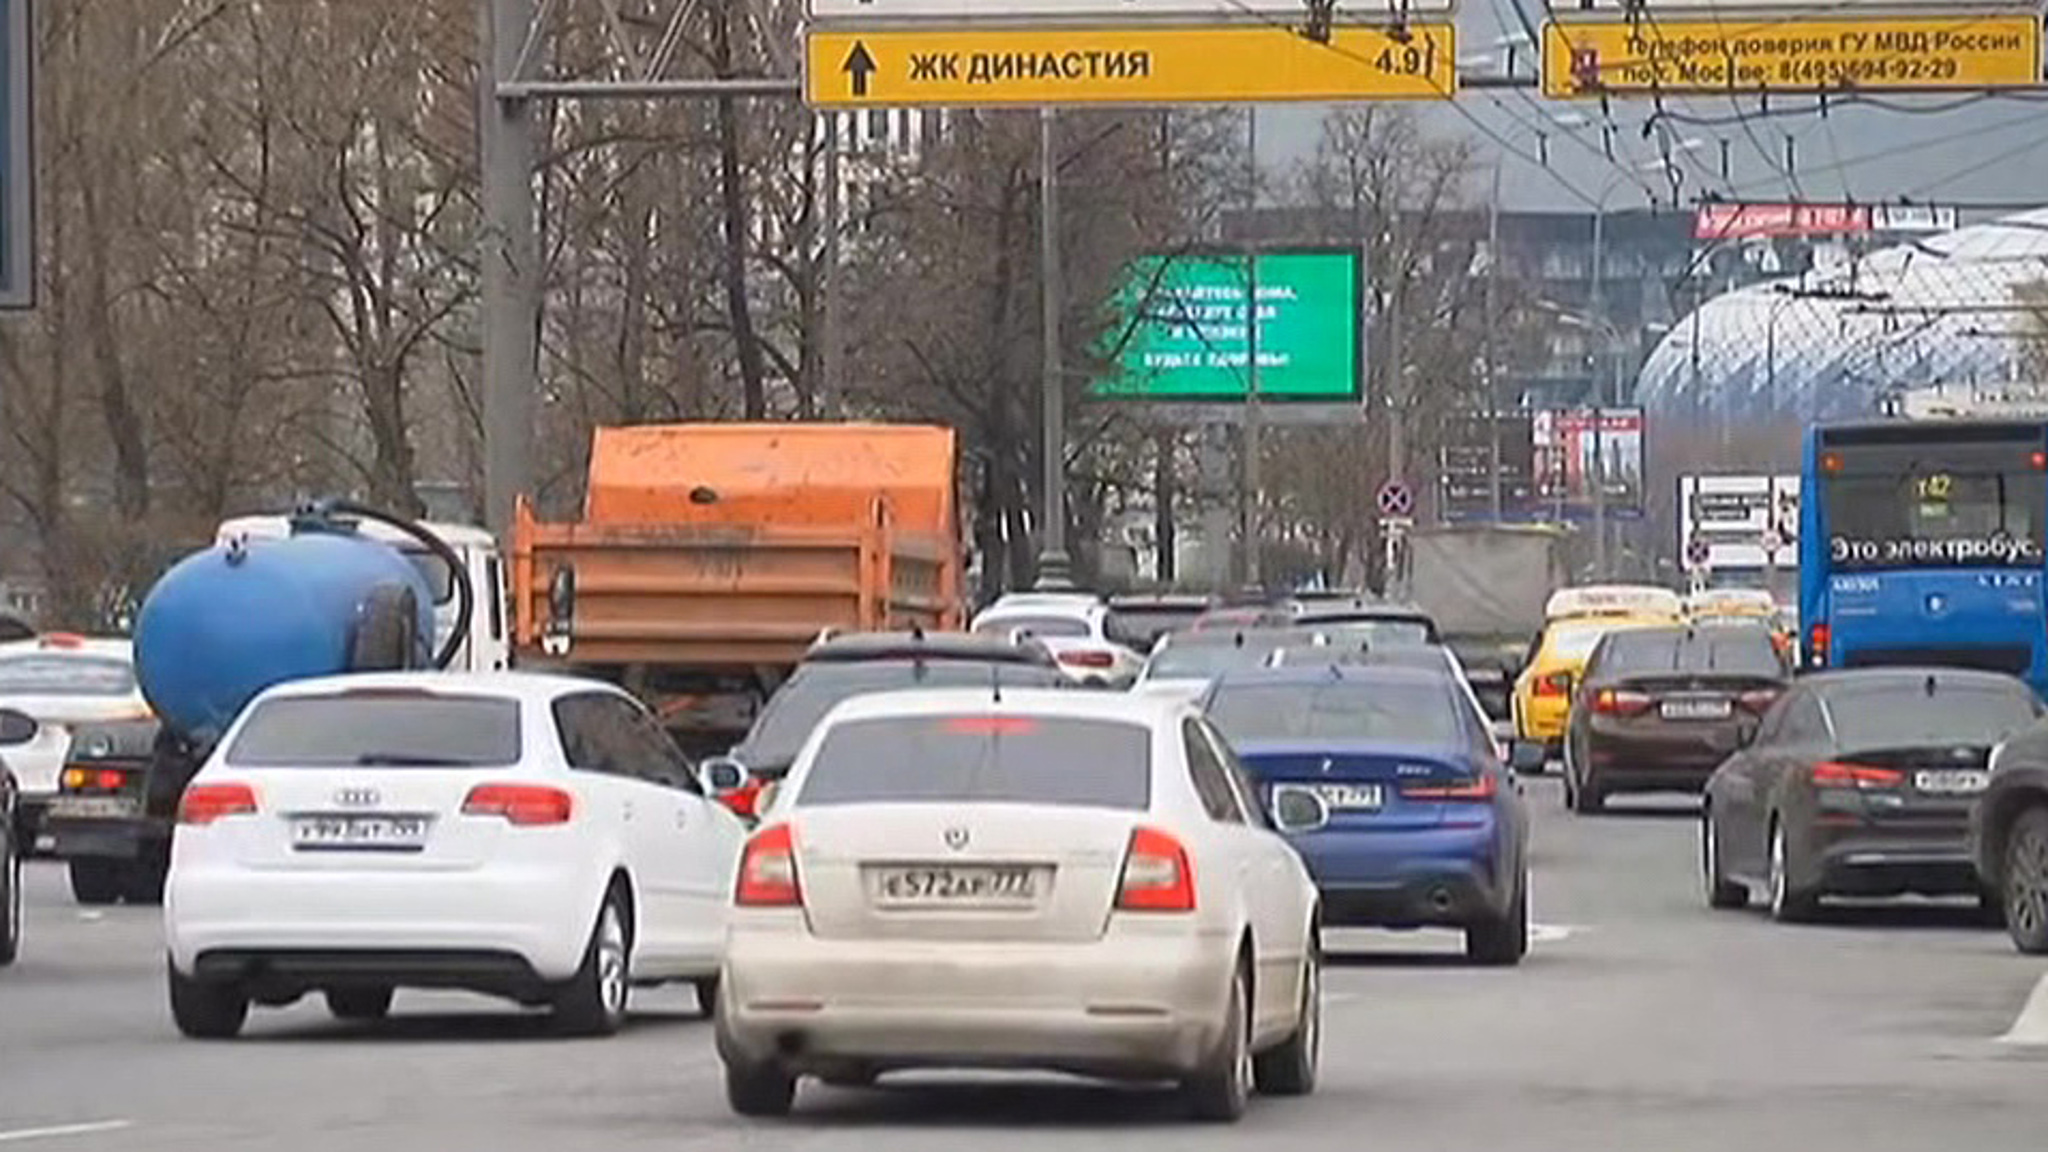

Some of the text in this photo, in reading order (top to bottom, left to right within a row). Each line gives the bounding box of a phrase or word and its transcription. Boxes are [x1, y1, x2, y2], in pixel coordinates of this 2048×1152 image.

[1733, 37, 1834, 57] доверия
[1840, 33, 1868, 52] ГУ
[1874, 32, 1930, 54] МВД
[1934, 32, 2021, 51] России
[910, 46, 1419, 84] ЖК ДИНАСТИЯ 4.9
[1832, 532, 2043, 564] Это электробус.
